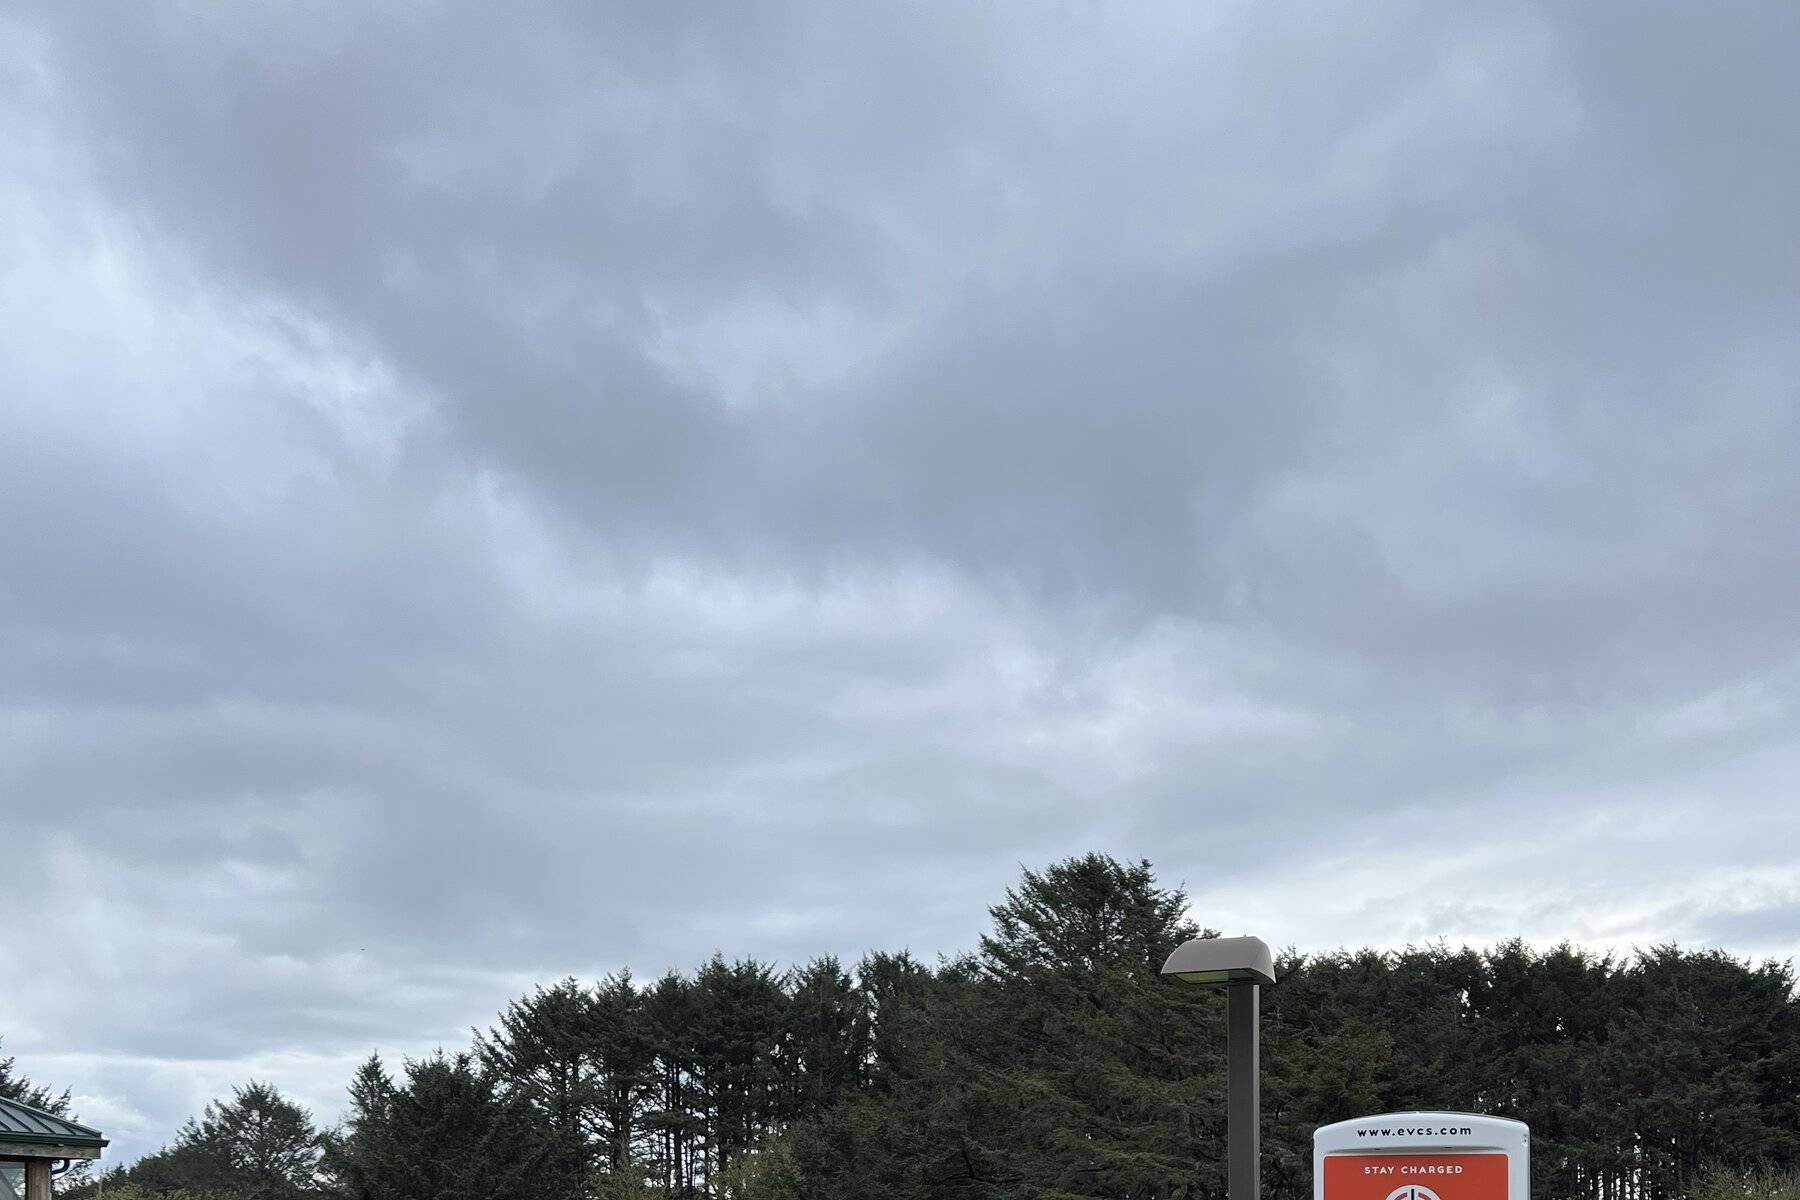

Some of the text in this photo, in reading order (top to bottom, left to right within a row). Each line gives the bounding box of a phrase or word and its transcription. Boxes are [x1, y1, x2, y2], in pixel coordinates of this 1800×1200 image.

[1357, 1127, 1472, 1137] www.evcs.com
[1364, 1165, 1463, 1174] STAY CHARGED
